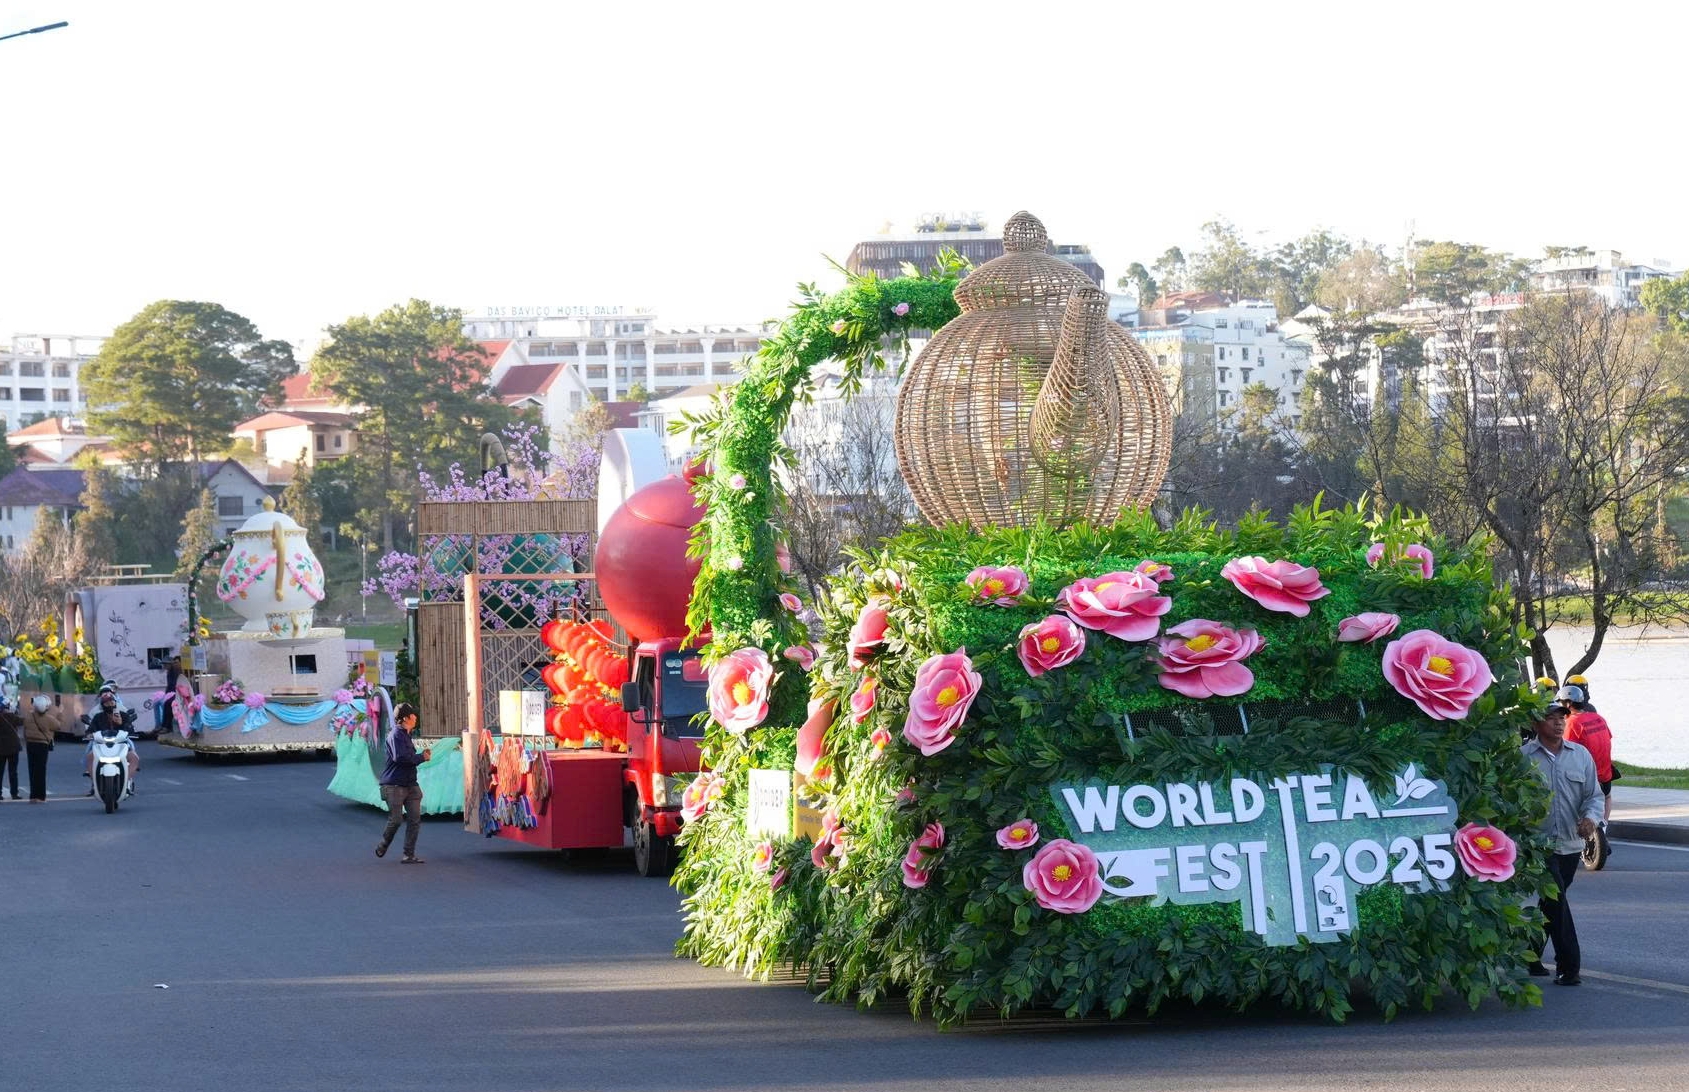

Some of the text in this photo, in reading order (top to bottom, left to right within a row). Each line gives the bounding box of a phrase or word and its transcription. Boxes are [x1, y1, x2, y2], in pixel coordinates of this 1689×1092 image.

[487, 305, 507, 316] DAS
[511, 305, 550, 316] BAVICO
[557, 305, 590, 316] HOTEL
[594, 305, 624, 315] DALAT
[1062, 776, 1265, 833] WORLD
[1096, 833, 1456, 935] FEST 2025
